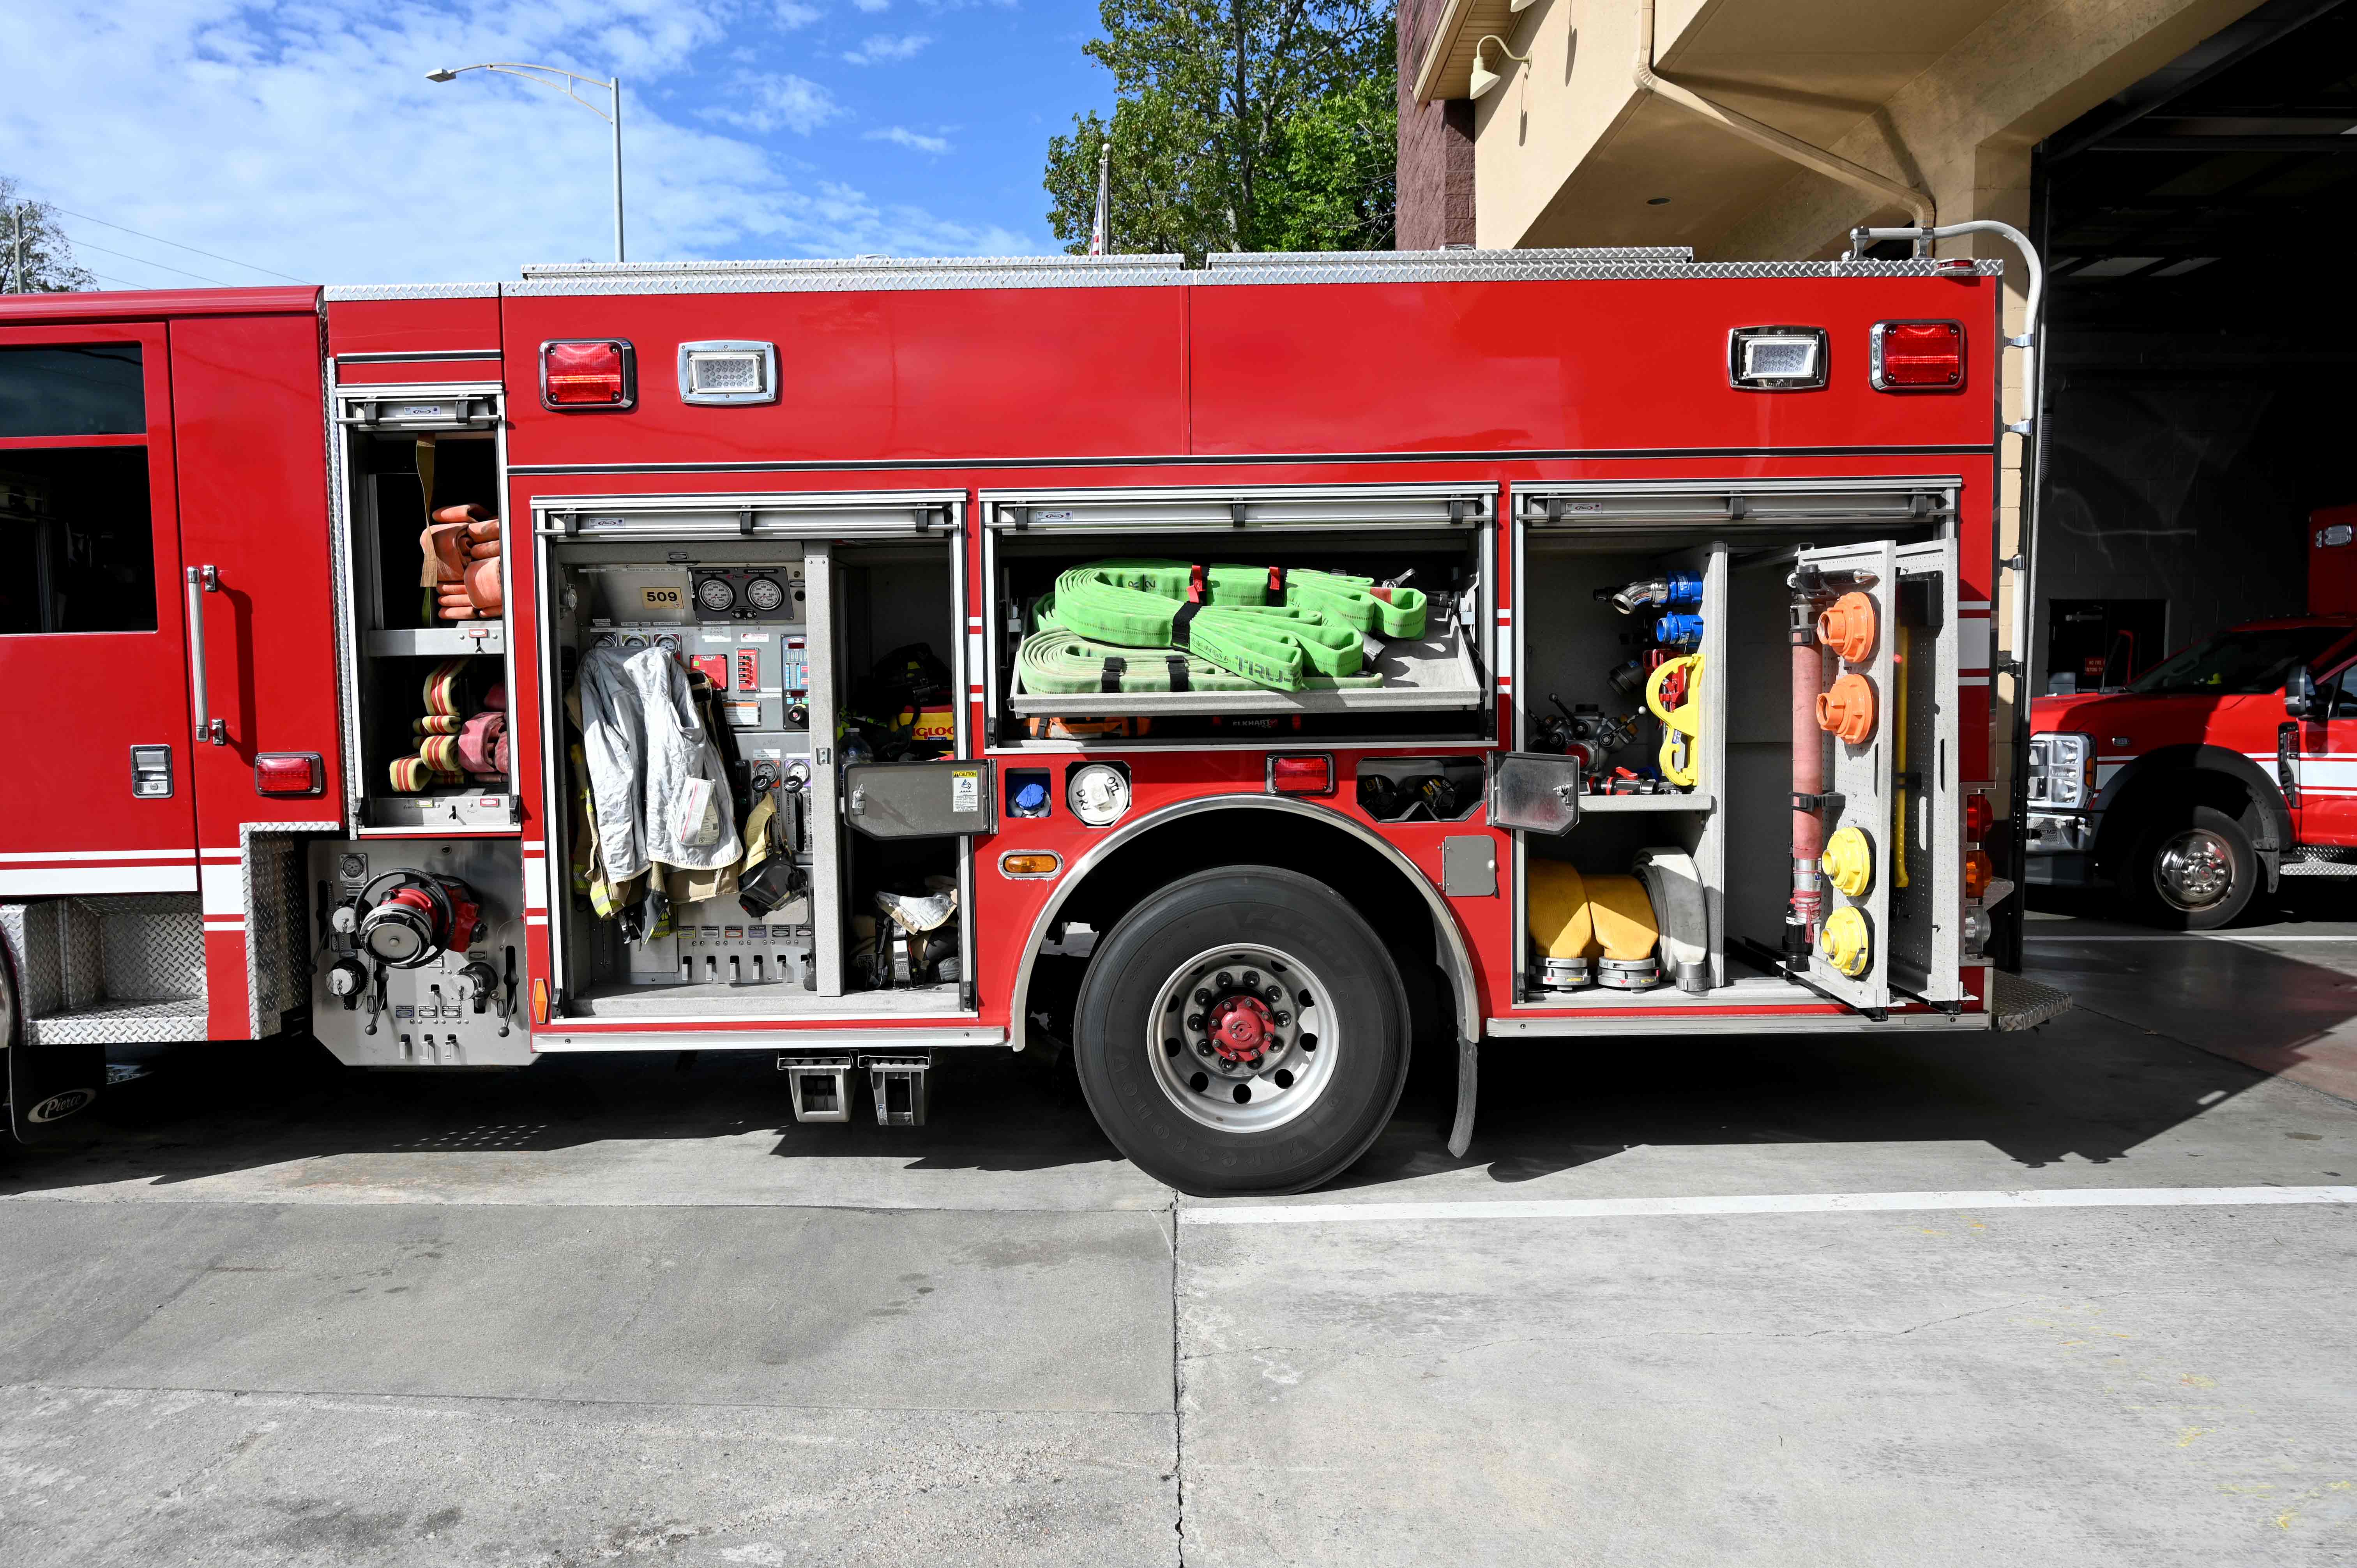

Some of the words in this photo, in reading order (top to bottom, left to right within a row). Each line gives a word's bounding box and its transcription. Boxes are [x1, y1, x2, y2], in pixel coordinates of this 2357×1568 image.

[647, 592, 677, 602] 509
[1107, 777, 1120, 796] OIL
[1076, 789, 1092, 810] DRY
[44, 1094, 81, 1119] Pierce
